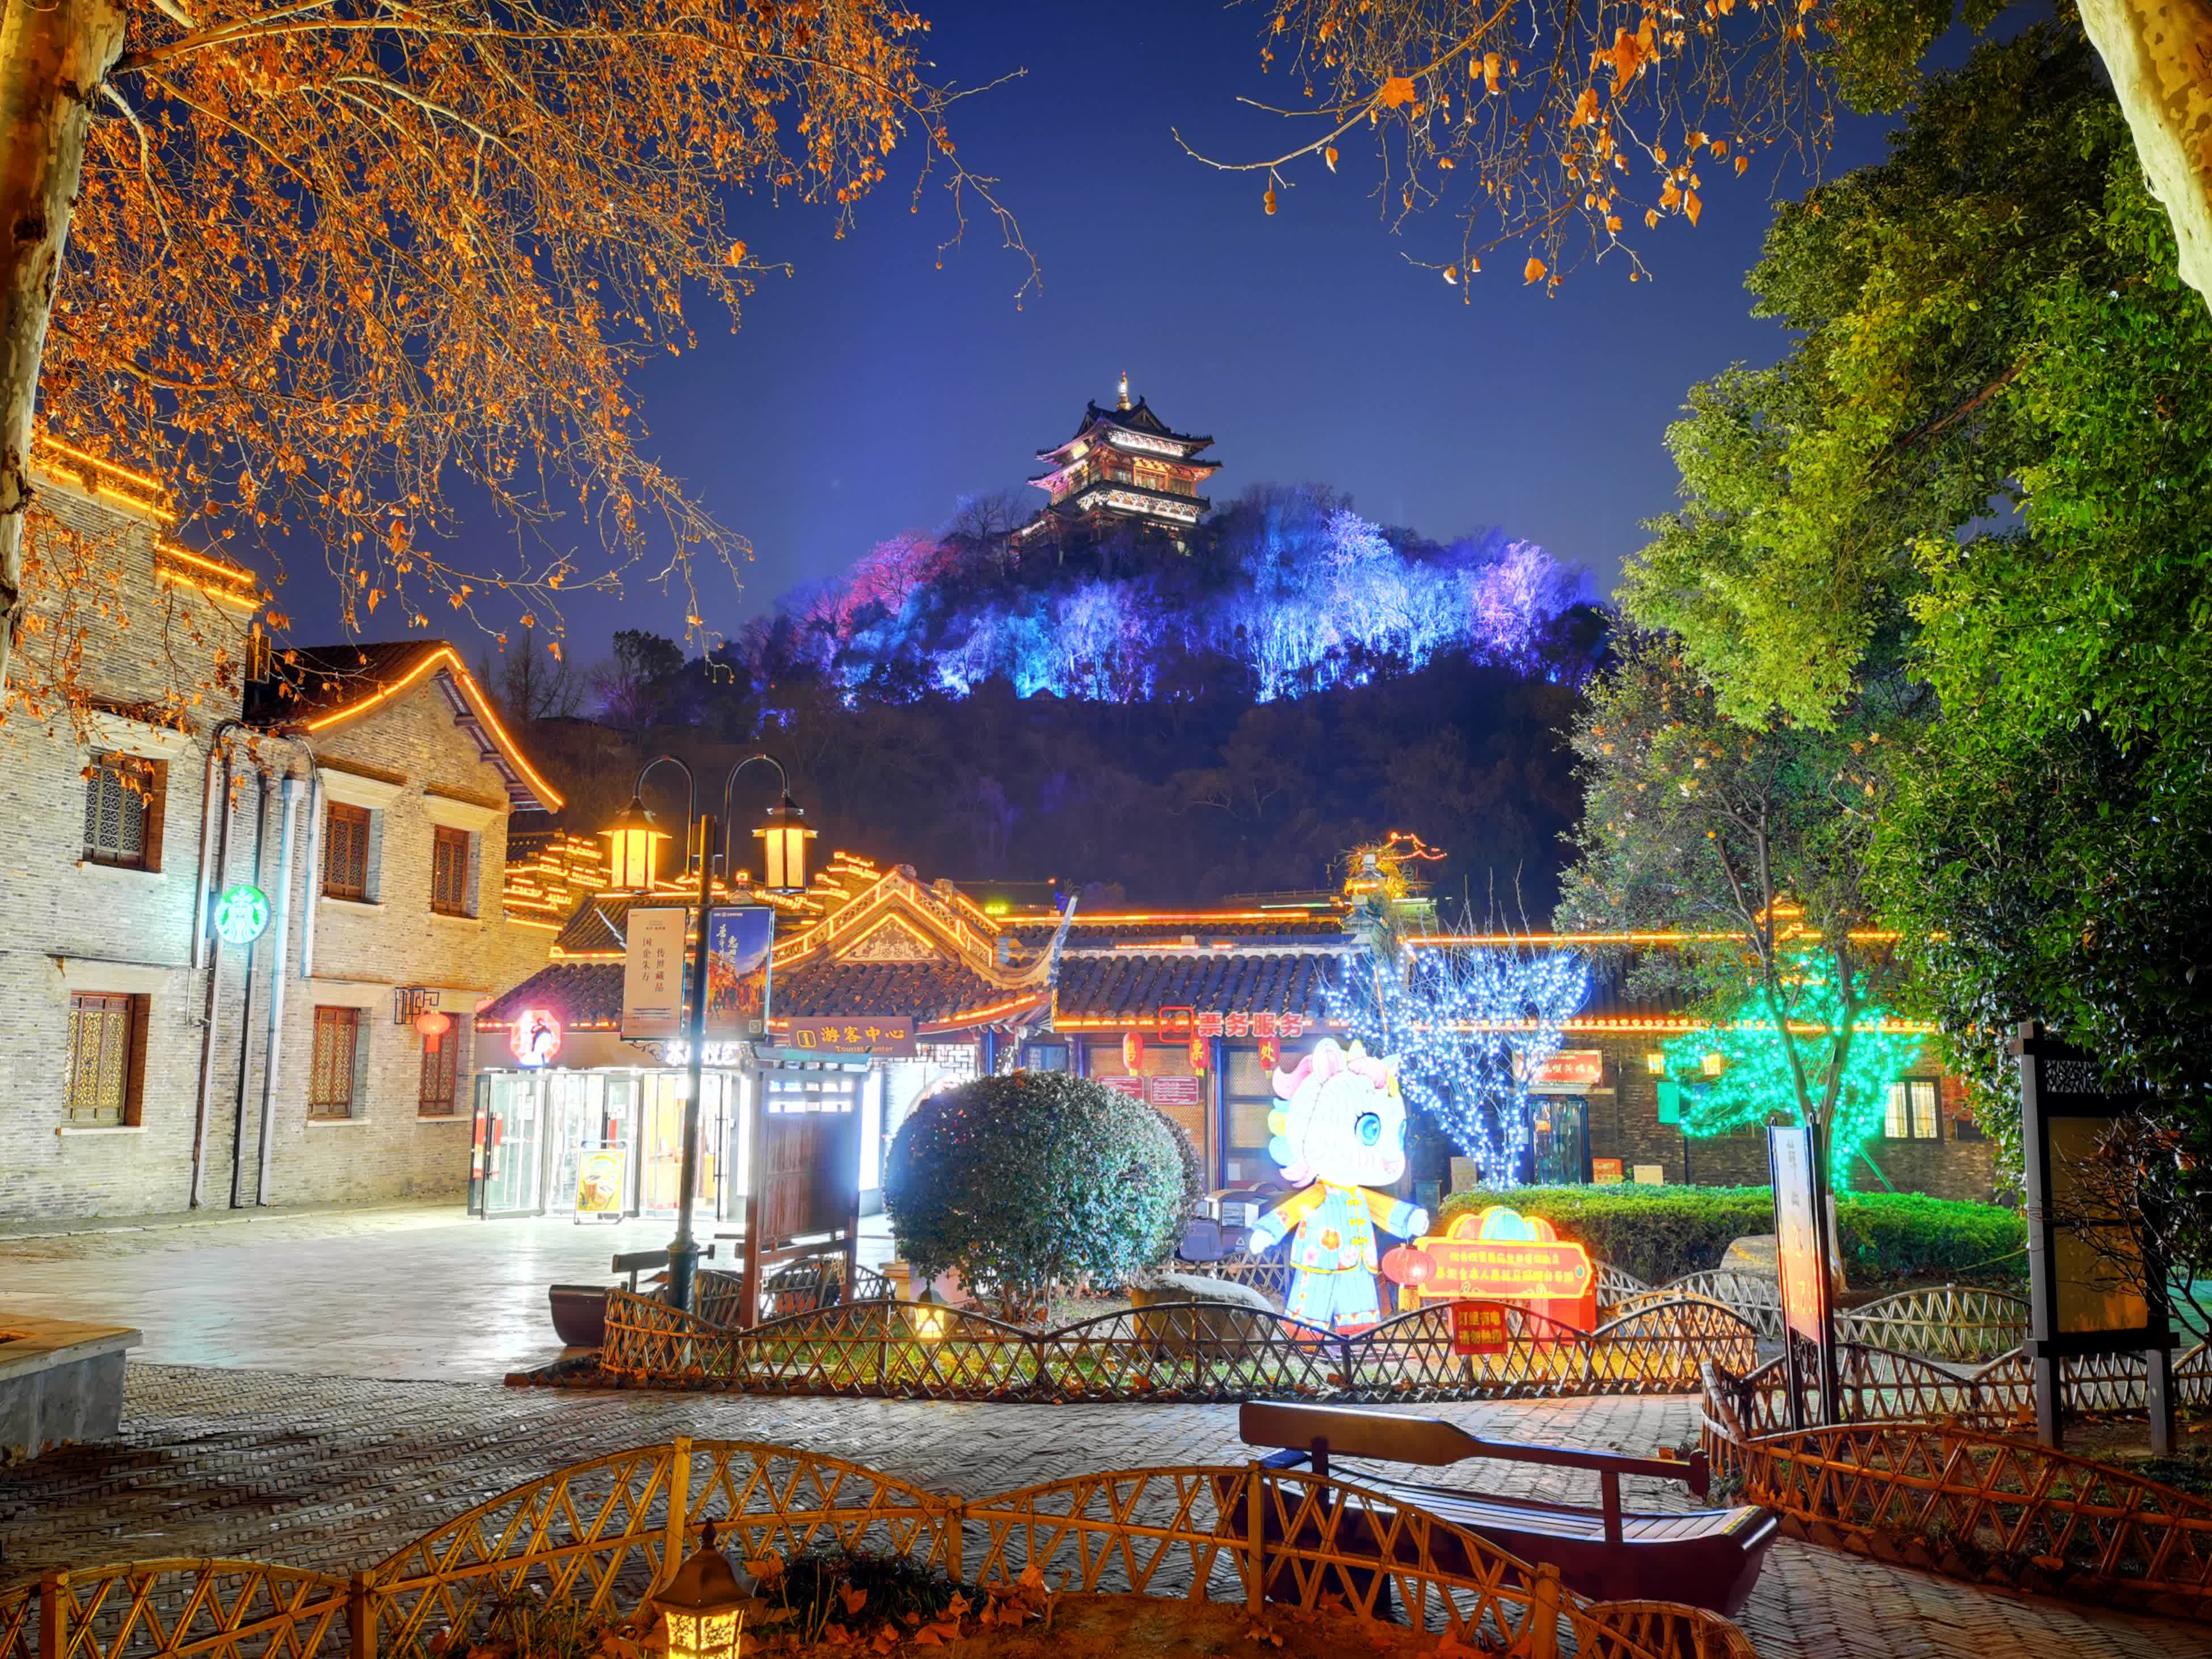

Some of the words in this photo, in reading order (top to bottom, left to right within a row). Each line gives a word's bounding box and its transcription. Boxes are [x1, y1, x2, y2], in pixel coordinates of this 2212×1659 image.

[821, 1026, 905, 1043] 游客中心
[1198, 1012, 1303, 1038] 票务服务
[1192, 1039, 1203, 1060] 票
[1261, 1041, 1275, 1062] 处
